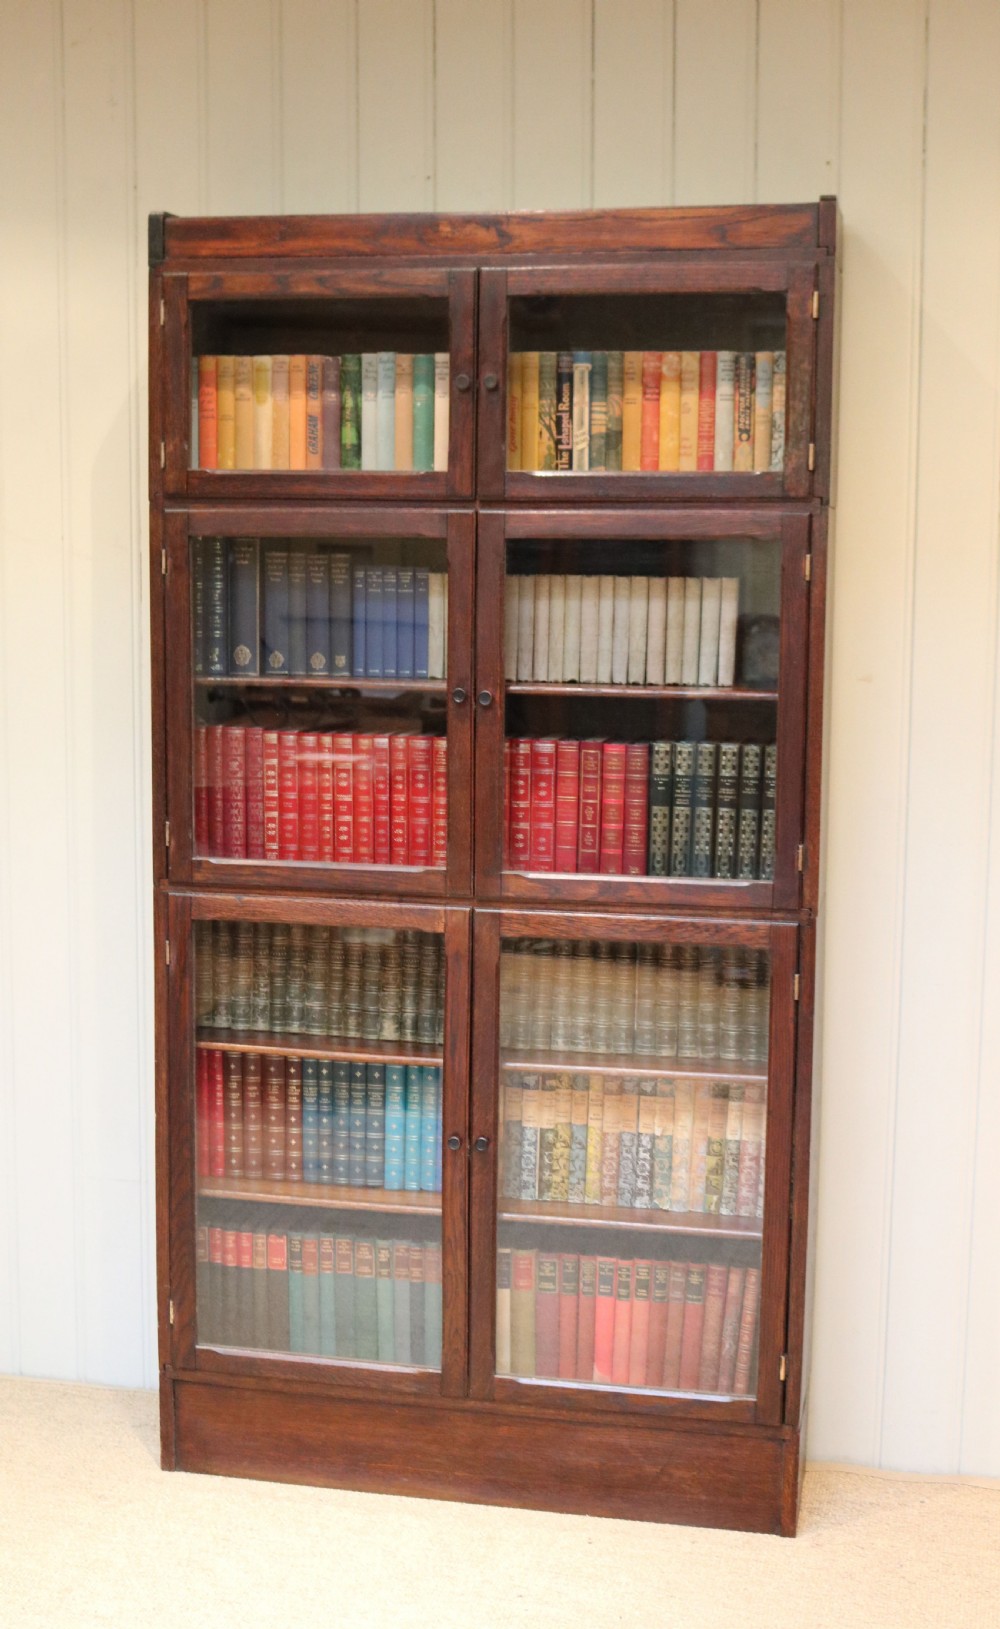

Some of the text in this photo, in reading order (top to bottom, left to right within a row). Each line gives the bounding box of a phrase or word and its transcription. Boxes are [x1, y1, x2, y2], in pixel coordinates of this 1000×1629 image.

[306, 361, 319, 455] GRAHAM GREENE
[558, 383, 570, 411] Room
[554, 449, 570, 470] The
